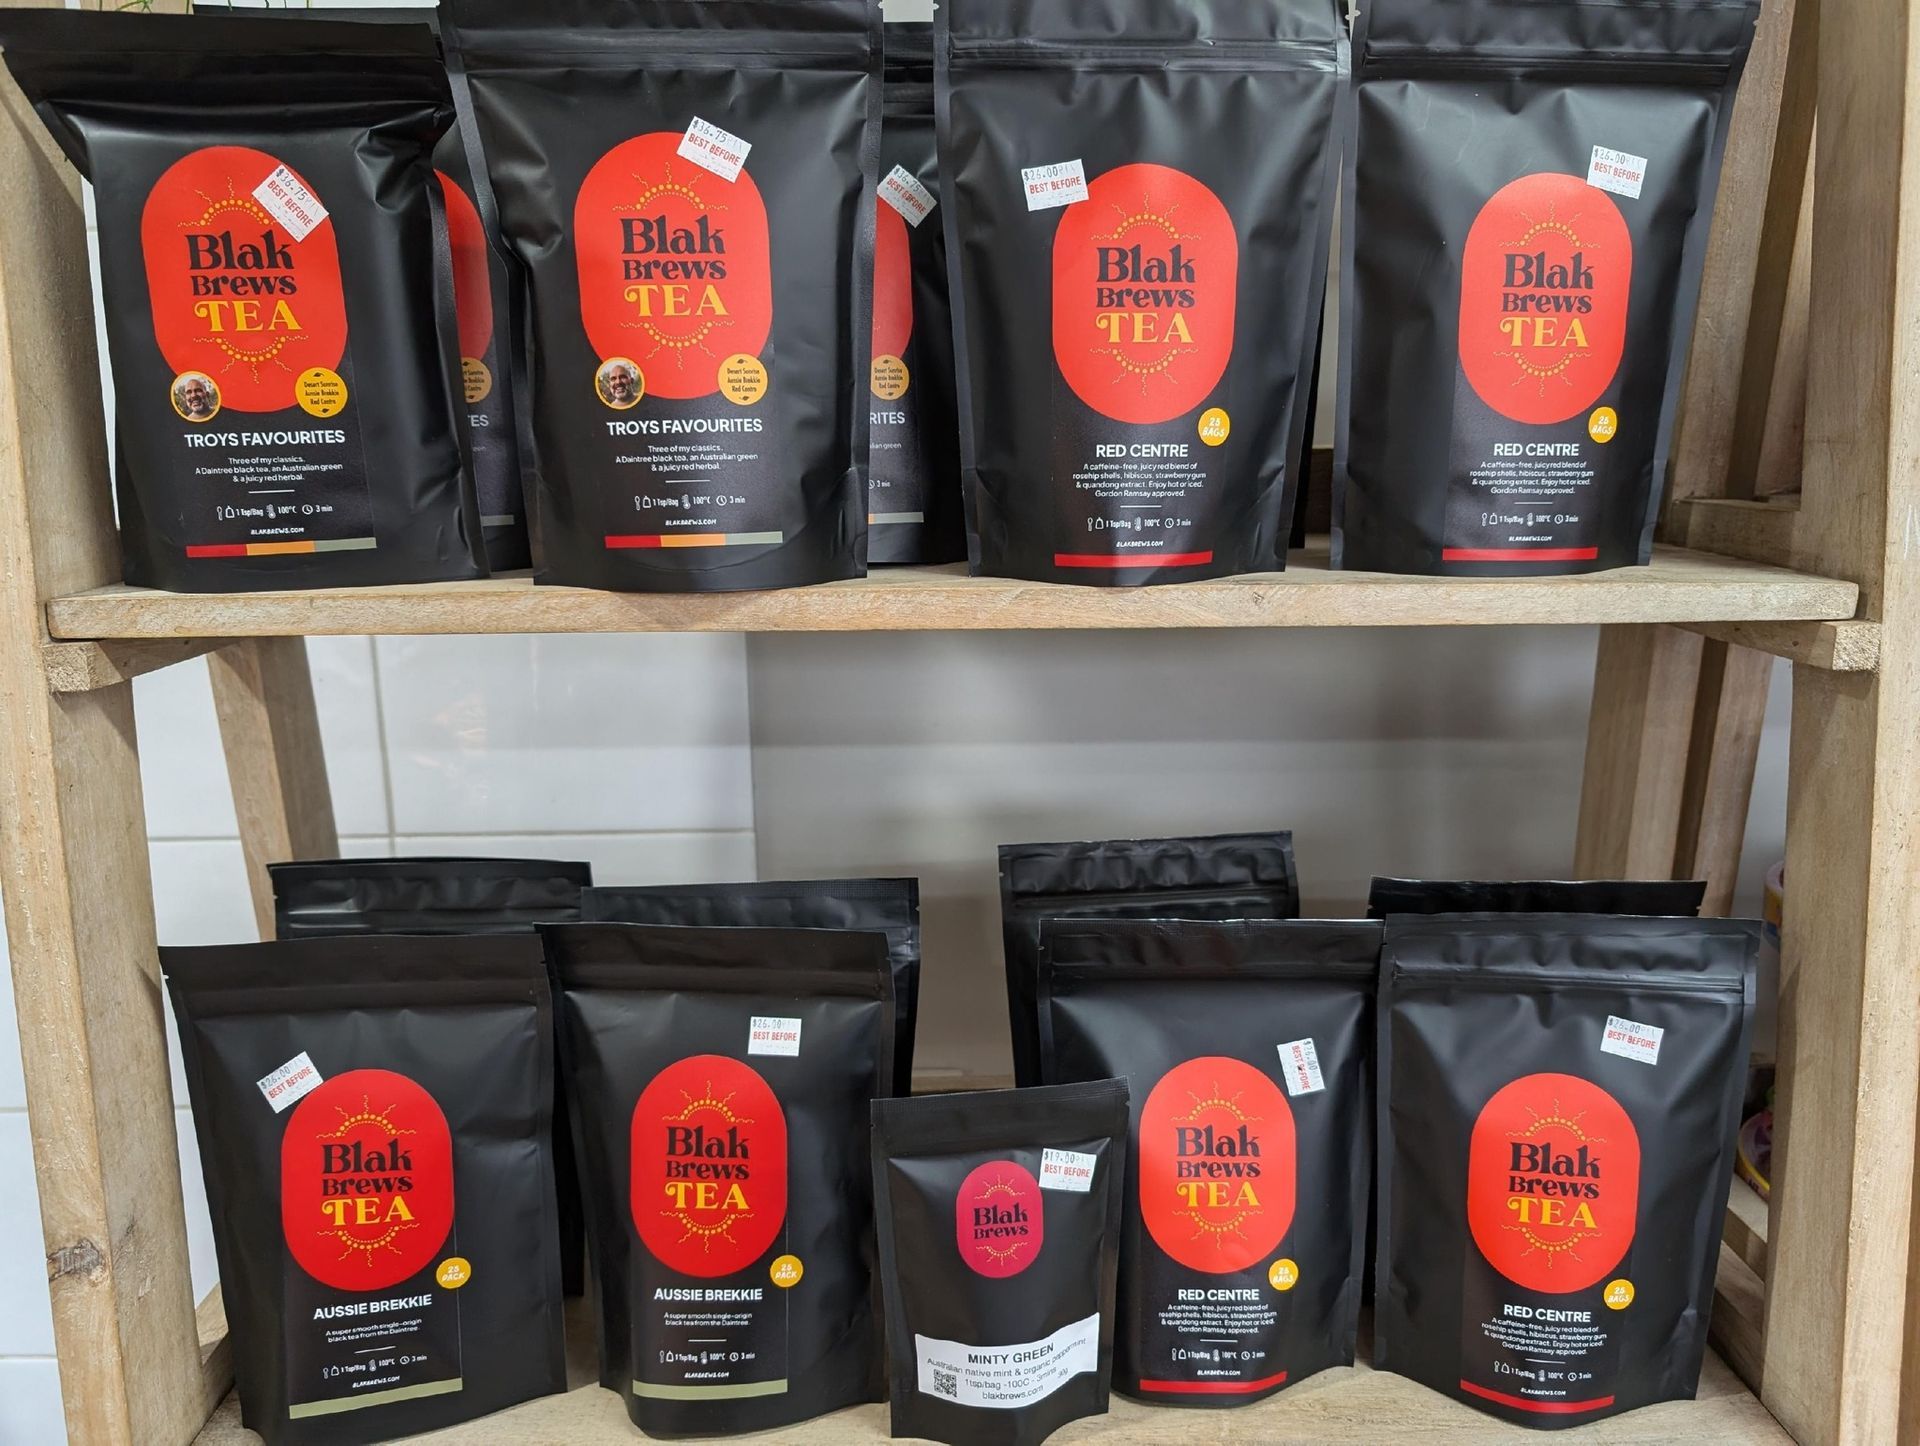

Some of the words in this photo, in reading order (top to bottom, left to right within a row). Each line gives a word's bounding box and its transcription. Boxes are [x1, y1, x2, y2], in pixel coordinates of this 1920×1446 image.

[688, 133, 710, 149] BEST
[709, 145, 740, 166] BEFORE
[1594, 162, 1612, 173] BEST
[1613, 167, 1641, 182] BEFORE
[1029, 182, 1049, 194] BEST
[1050, 176, 1082, 190] BEFORE
[267, 180, 286, 203] BEST
[285, 197, 313, 227] BEFORE
[887, 178, 904, 193] BEST
[902, 191, 927, 214] BEFORE
[620, 215, 725, 254] Blak
[185, 230, 294, 270] Blak
[624, 260, 727, 280] Brews
[1096, 244, 1195, 283] Blak
[1503, 252, 1594, 289] Blak
[191, 275, 297, 296] Brews
[624, 285, 729, 316] TEA
[1096, 288, 1194, 308] Brews
[1502, 293, 1592, 313] Brews
[194, 300, 302, 331] TEA
[1095, 313, 1194, 343] TEA
[1500, 317, 1589, 347] TEA
[606, 421, 659, 435] TROYS
[663, 418, 762, 433] FAVOURITES
[1202, 427, 1224, 437] BAGS
[184, 434, 238, 447] TROYS
[242, 430, 345, 445] FAVOURITES
[1096, 445, 1126, 457] RED
[1130, 444, 1188, 457] CENTRE
[1494, 444, 1523, 456] RED
[1526, 444, 1579, 456] CENTRE
[260, 457, 272, 465] my
[321, 463, 343, 471] green
[1140, 463, 1156, 471] juicy
[245, 475, 263, 483] juicy
[1082, 481, 1119, 489] quandong
[1149, 481, 1167, 489] Enjoy
[1124, 490, 1151, 498] Ramsay
[753, 1031, 770, 1040] BEST
[772, 1032, 797, 1041] BEFORE
[1608, 1030, 1626, 1041] BEST
[1627, 1036, 1656, 1049] BEFORE
[1292, 1045, 1301, 1066] BEST
[269, 1082, 287, 1098] BEST
[287, 1066, 313, 1087] BEFORE
[666, 1125, 749, 1159] Blak
[1176, 1125, 1260, 1157] Blak
[322, 1138, 412, 1174] Blak
[1509, 1142, 1601, 1179] Blak
[666, 1161, 749, 1180] Brews
[1044, 1164, 1062, 1173] BEST
[1064, 1166, 1090, 1177] BEFORE
[1177, 1161, 1260, 1178] Brews
[323, 1175, 413, 1196] Brews
[665, 1181, 749, 1209] TEA
[1176, 1181, 1260, 1207] TEA
[1509, 1176, 1599, 1199] Brews
[322, 1196, 414, 1226] TEA
[974, 1203, 1027, 1226] Blak
[1507, 1197, 1597, 1229] TEA
[974, 1225, 1028, 1239] Brews
[442, 1273, 464, 1281] PACK
[775, 1271, 797, 1279] PACK
[654, 1288, 702, 1300] AUSSIE
[705, 1289, 762, 1300] BREKKIE
[1178, 1289, 1204, 1300] RED
[1207, 1289, 1259, 1300] CENTRE
[314, 1303, 368, 1319] AUSSIE
[370, 1294, 432, 1313] BREKKIE
[1504, 1304, 1532, 1318] RED
[1536, 1308, 1591, 1322] CENTRE
[380, 1319, 422, 1330] single-origin
[928, 1358, 963, 1373] Australian
[965, 1368, 991, 1377] native
[994, 1368, 1012, 1377] mint
[1023, 1359, 1050, 1376] organic
[1052, 1338, 1086, 1364] peppermint
[968, 1354, 1009, 1364] MINTY
[1013, 1343, 1054, 1363] GREEN
[983, 1386, 1043, 1400] blakbrews.com
